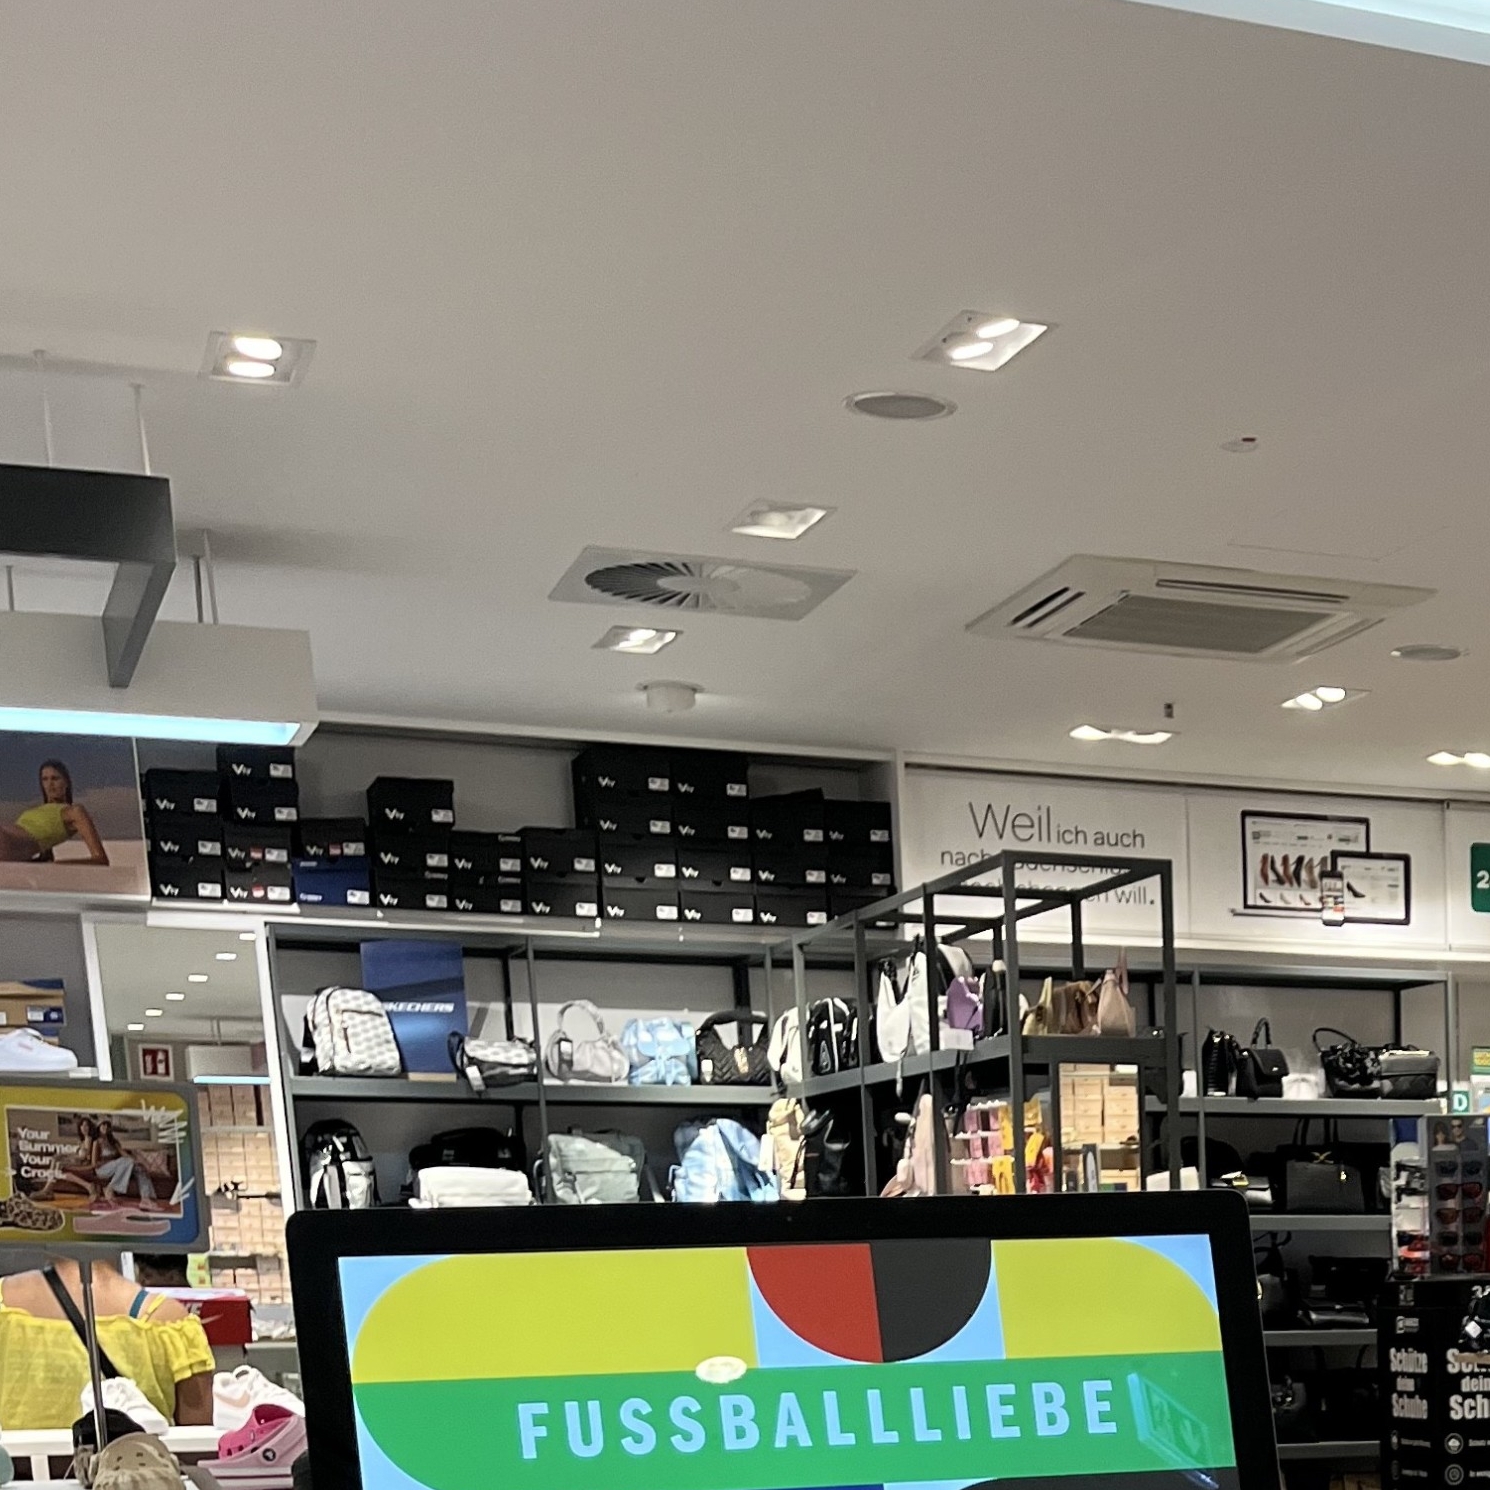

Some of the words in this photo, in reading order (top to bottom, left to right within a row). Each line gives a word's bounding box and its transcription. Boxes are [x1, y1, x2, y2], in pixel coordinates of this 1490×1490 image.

[968, 801, 1051, 842] Weil
[1056, 824, 1088, 845] ich
[1093, 829, 1146, 848] auch
[1453, 1093, 1468, 1110] D
[17, 1127, 51, 1140] Your
[20, 1153, 53, 1165] Your
[518, 1380, 1117, 1460] FUSSBALLLIEBE
